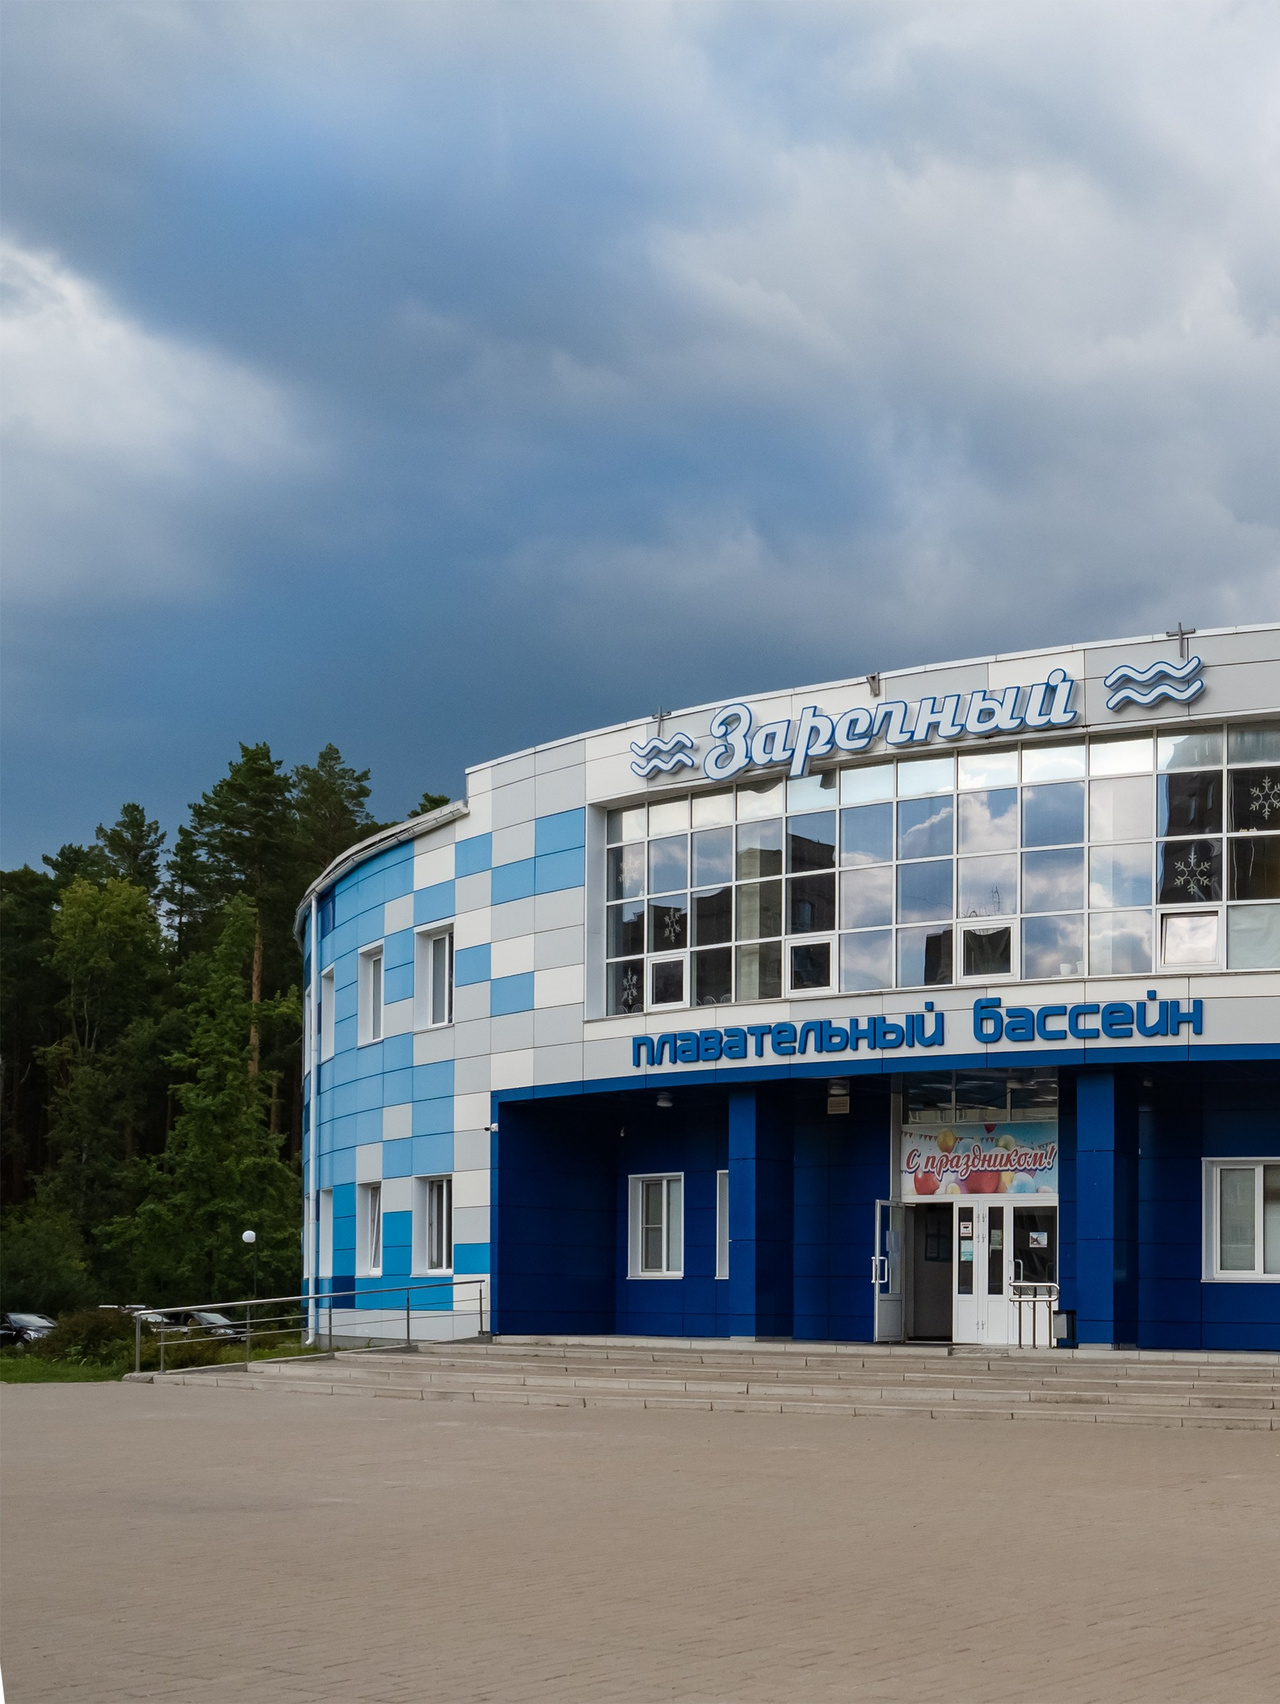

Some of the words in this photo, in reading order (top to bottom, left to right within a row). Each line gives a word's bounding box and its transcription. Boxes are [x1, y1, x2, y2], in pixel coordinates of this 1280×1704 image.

[632, 1001, 945, 1068] плавательный
[973, 989, 1204, 1043] бассейн
[906, 1147, 921, 1174] С
[924, 1141, 1057, 1180] праздником!
